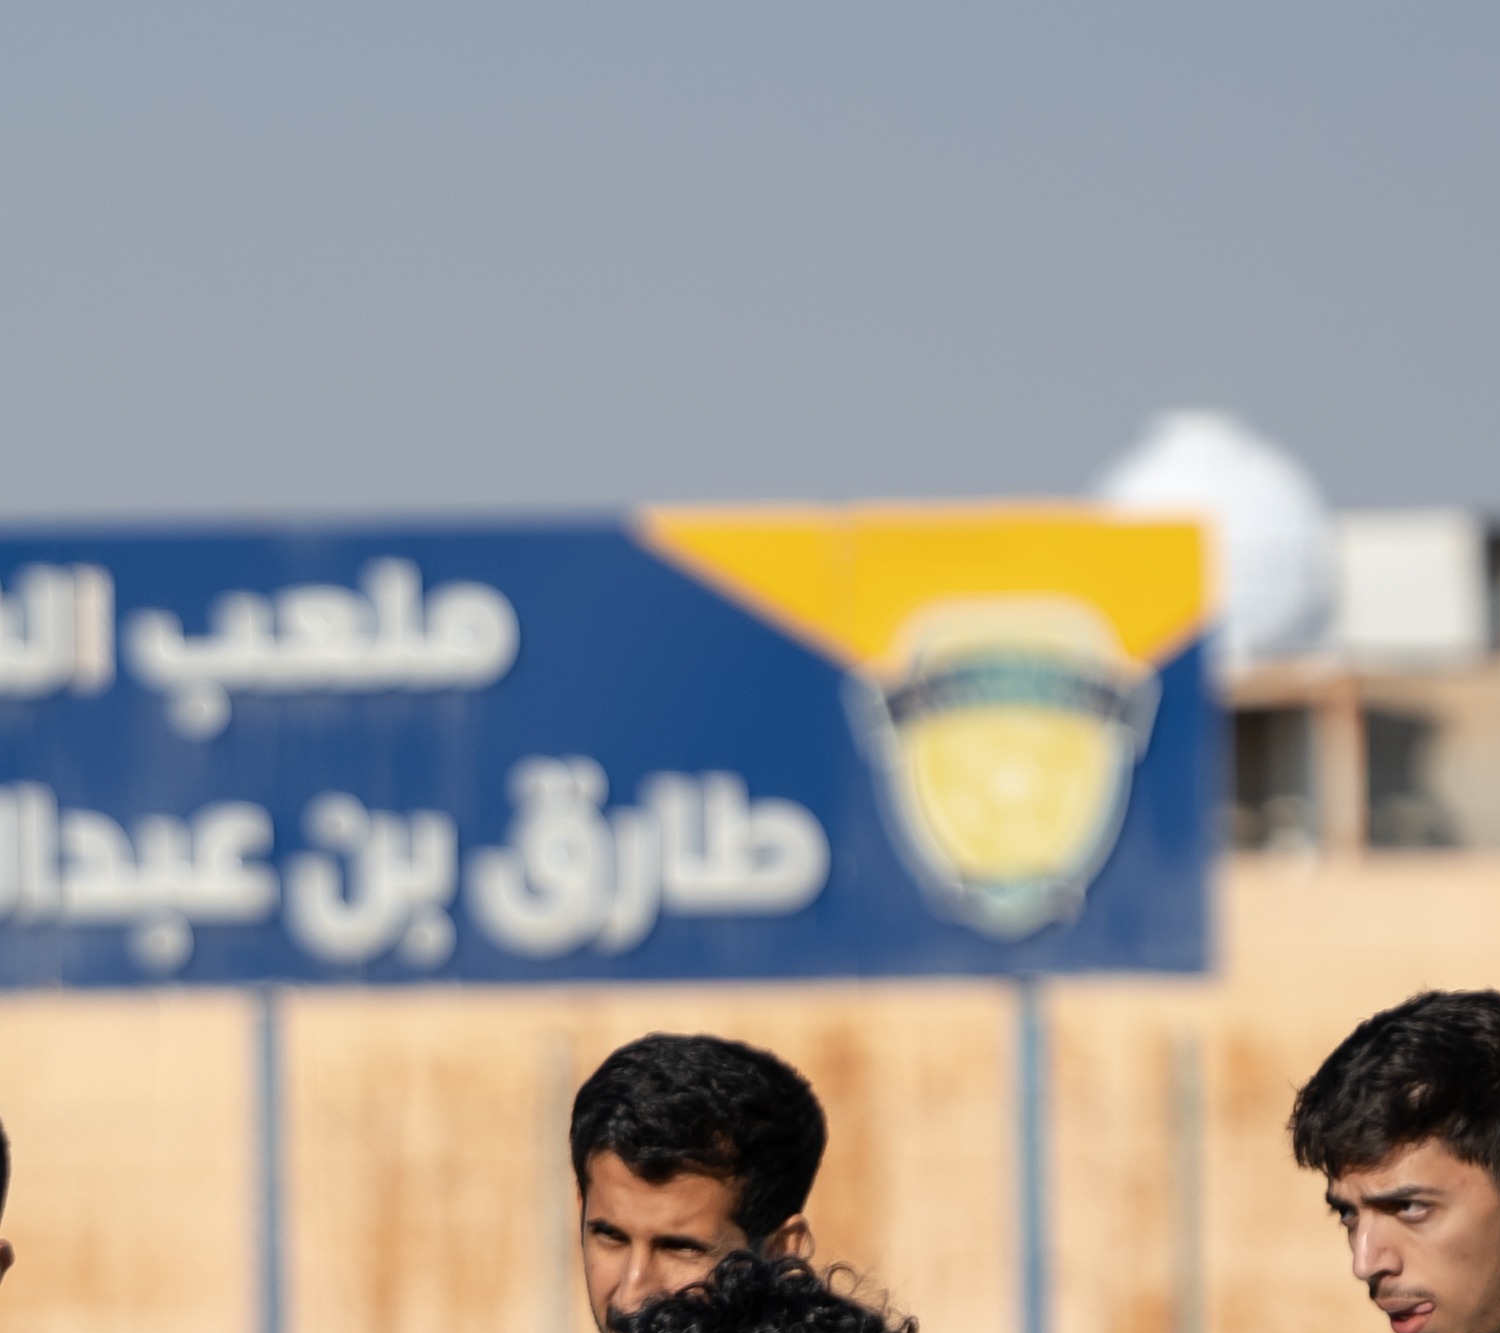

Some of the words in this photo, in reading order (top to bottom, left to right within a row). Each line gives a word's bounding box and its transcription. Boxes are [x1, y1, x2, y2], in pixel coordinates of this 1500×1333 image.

[122, 555, 520, 742] ملعب
[280, 791, 459, 970] بن
[464, 755, 832, 960] طارق
